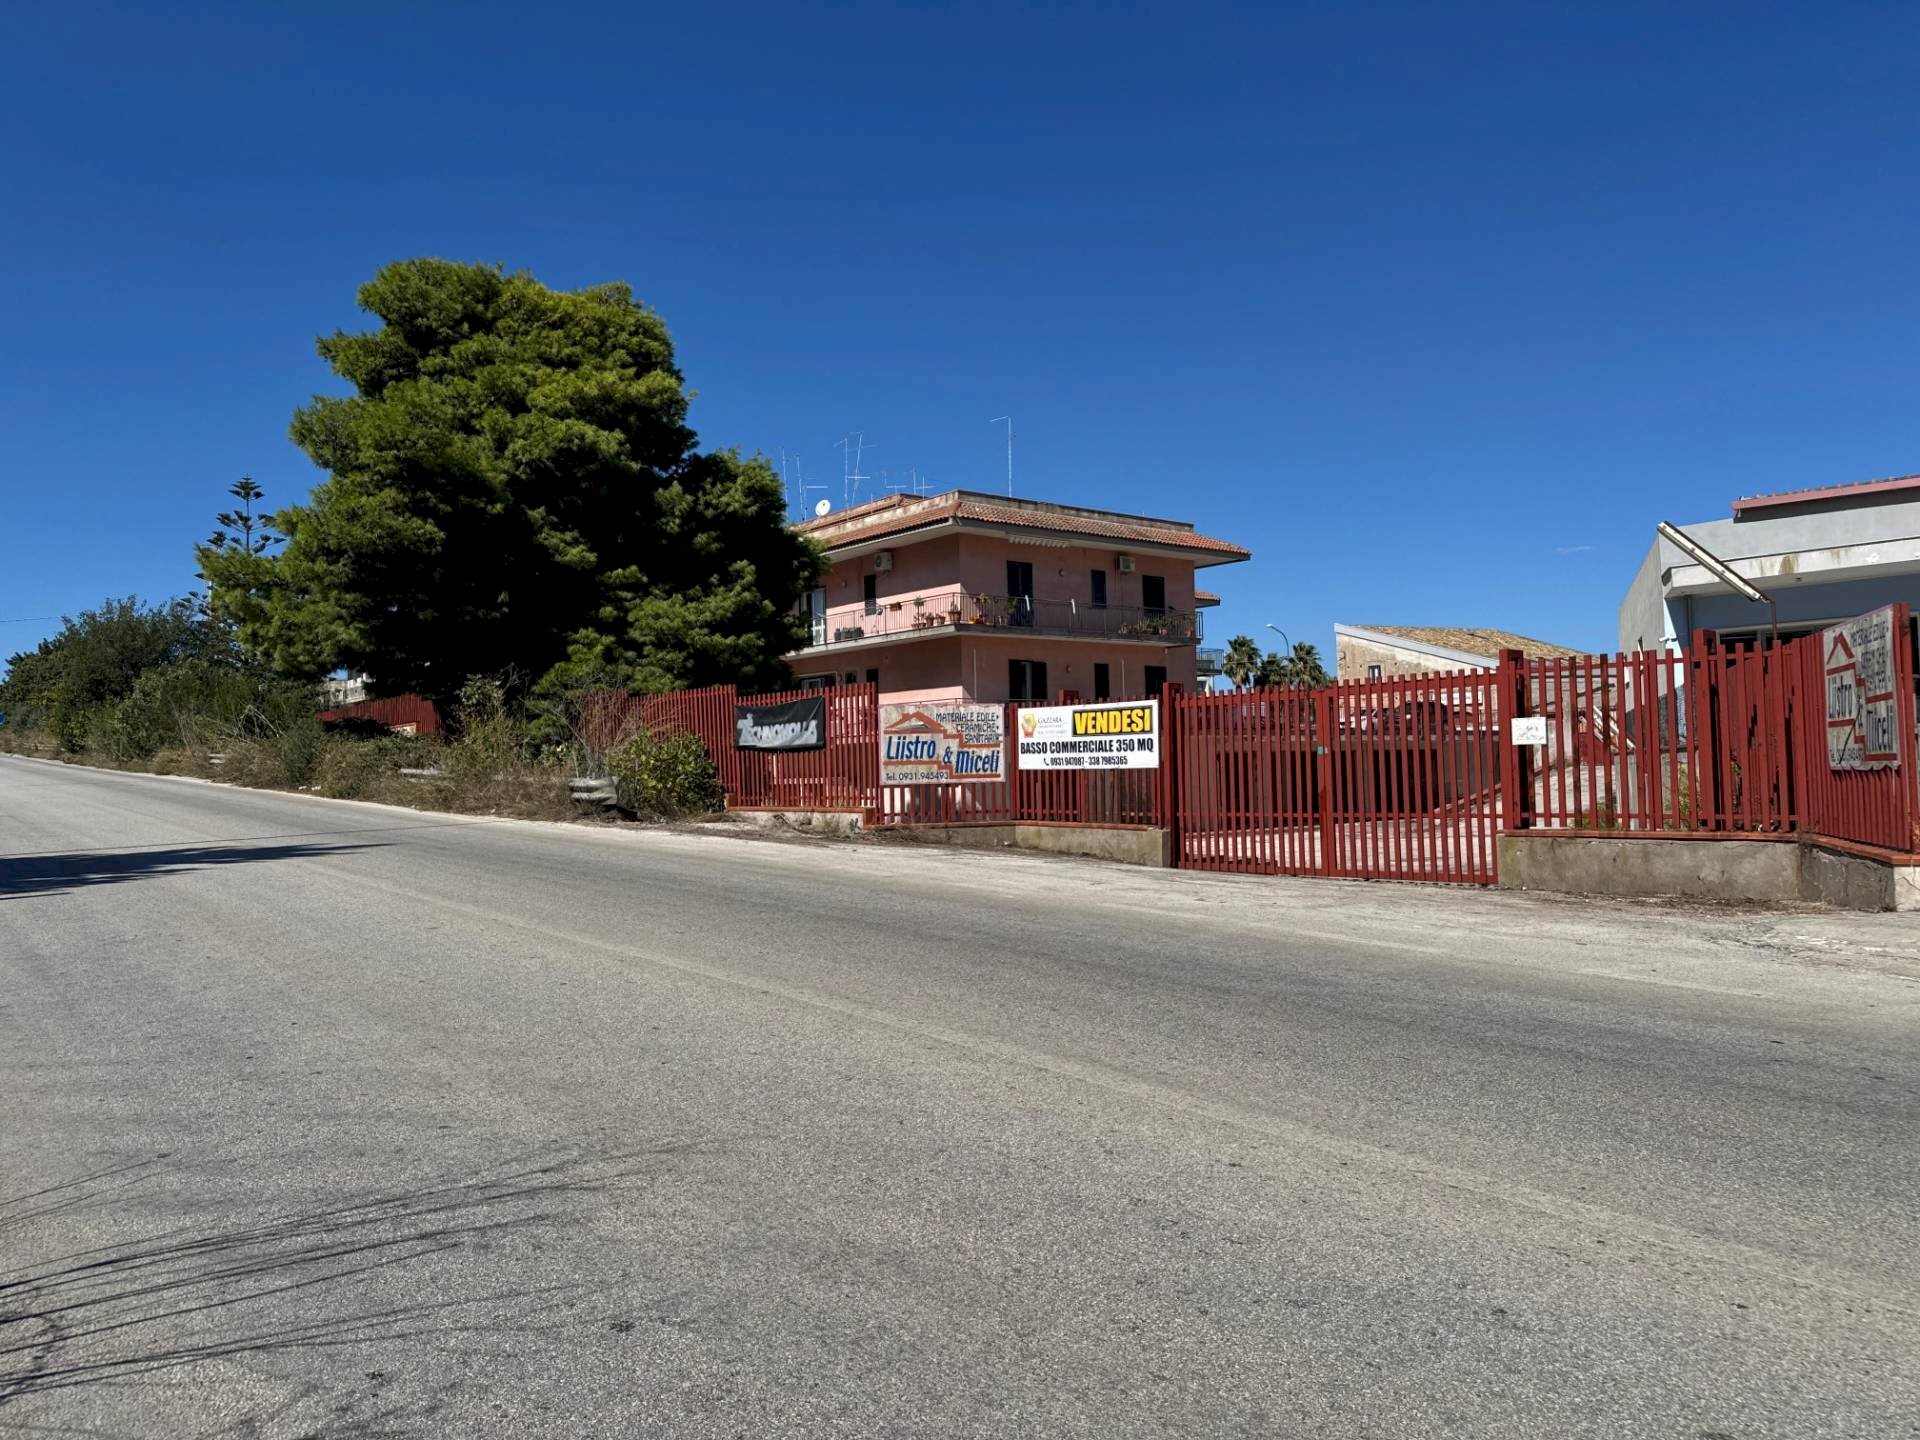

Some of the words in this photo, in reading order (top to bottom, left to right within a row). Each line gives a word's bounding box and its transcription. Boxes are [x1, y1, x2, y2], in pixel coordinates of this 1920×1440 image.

[936, 712, 974, 723] MATERIALE
[976, 712, 995, 722] EDILE
[1074, 708, 1151, 735] VENDESI
[887, 735, 936, 760] Liistro
[943, 746, 953, 765] &
[1020, 741, 1048, 754] BASSO
[1049, 739, 1113, 753] COMMERCIALE
[1116, 739, 1135, 752] 350
[1137, 738, 1153, 752] MQ
[955, 750, 1000, 773] Miceli
[1050, 757, 1064, 766] 0931
[1088, 756, 1100, 765] 338
